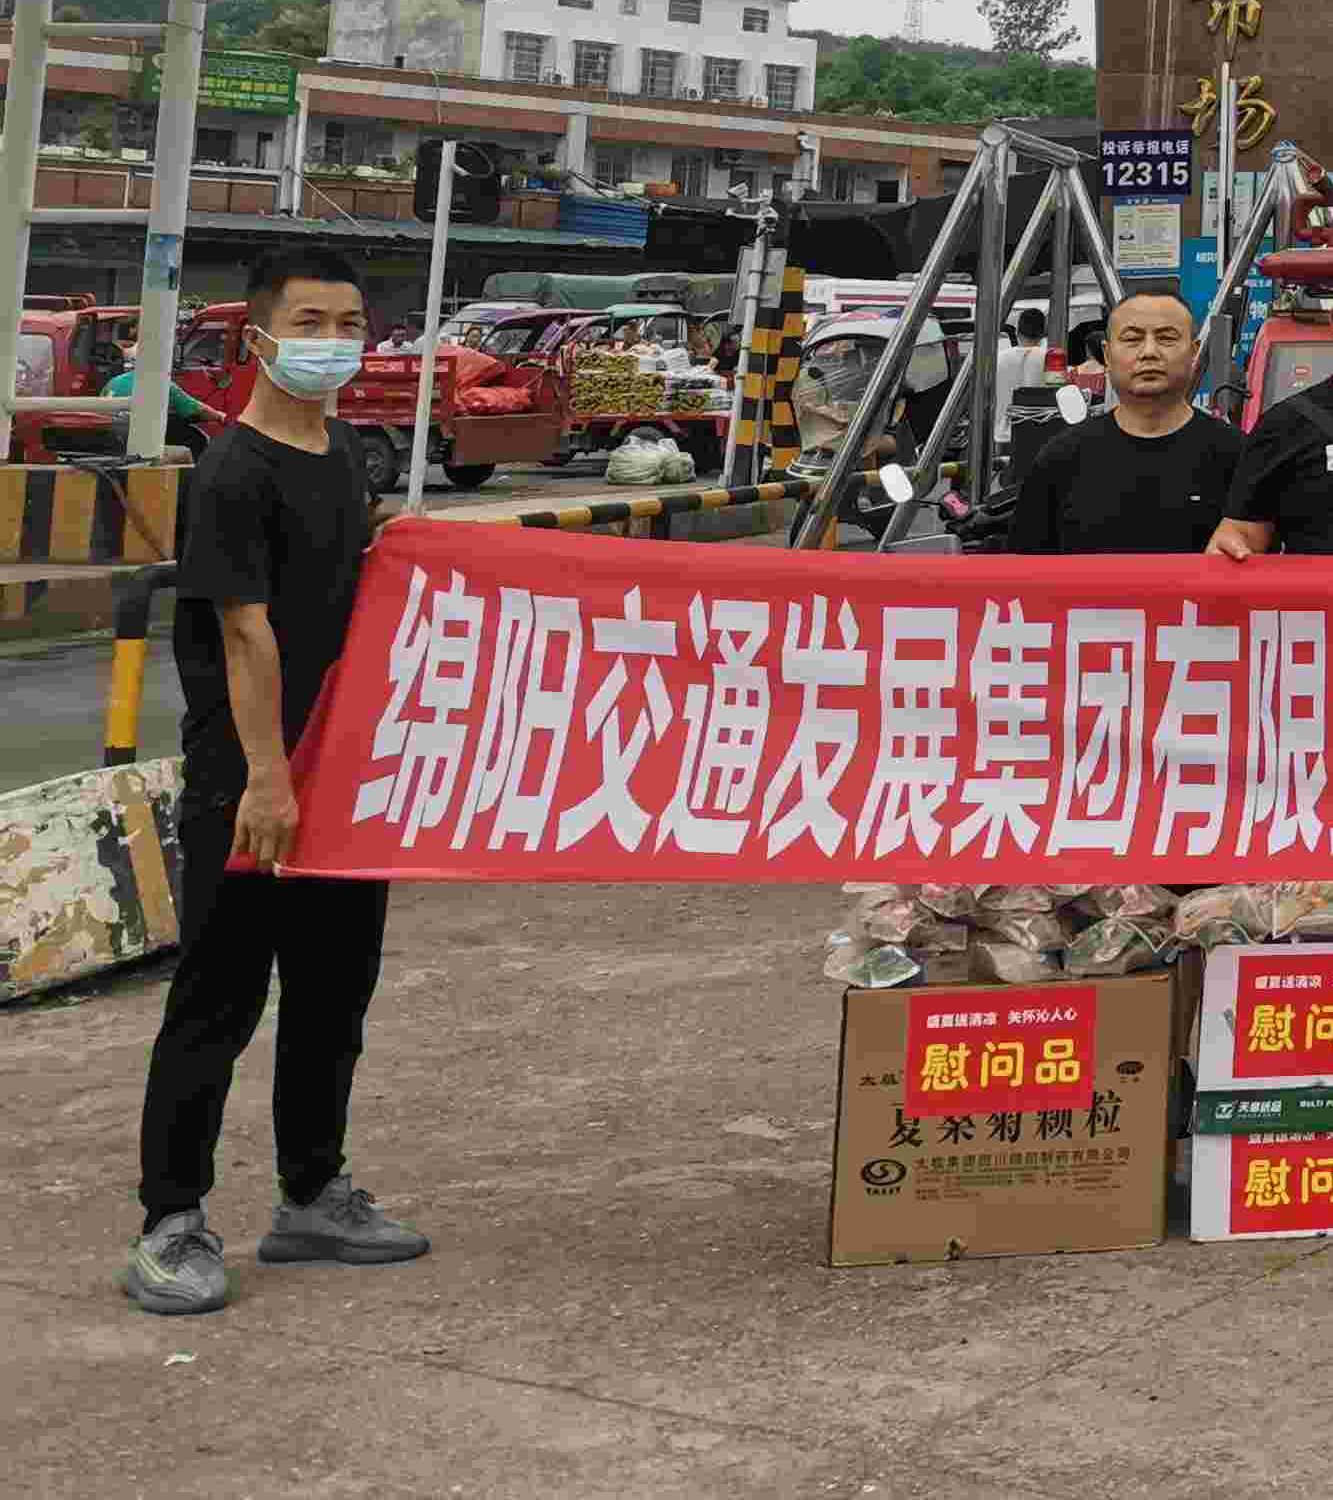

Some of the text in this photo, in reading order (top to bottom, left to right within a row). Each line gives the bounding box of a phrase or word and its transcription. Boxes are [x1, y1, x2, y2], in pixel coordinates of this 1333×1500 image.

[1102, 139, 1190, 156] 投诉举报电话
[1102, 161, 1190, 186] 12315
[1007, 1007, 1078, 1025] 关怀沁人心
[920, 1038, 1081, 1092] 慰问品
